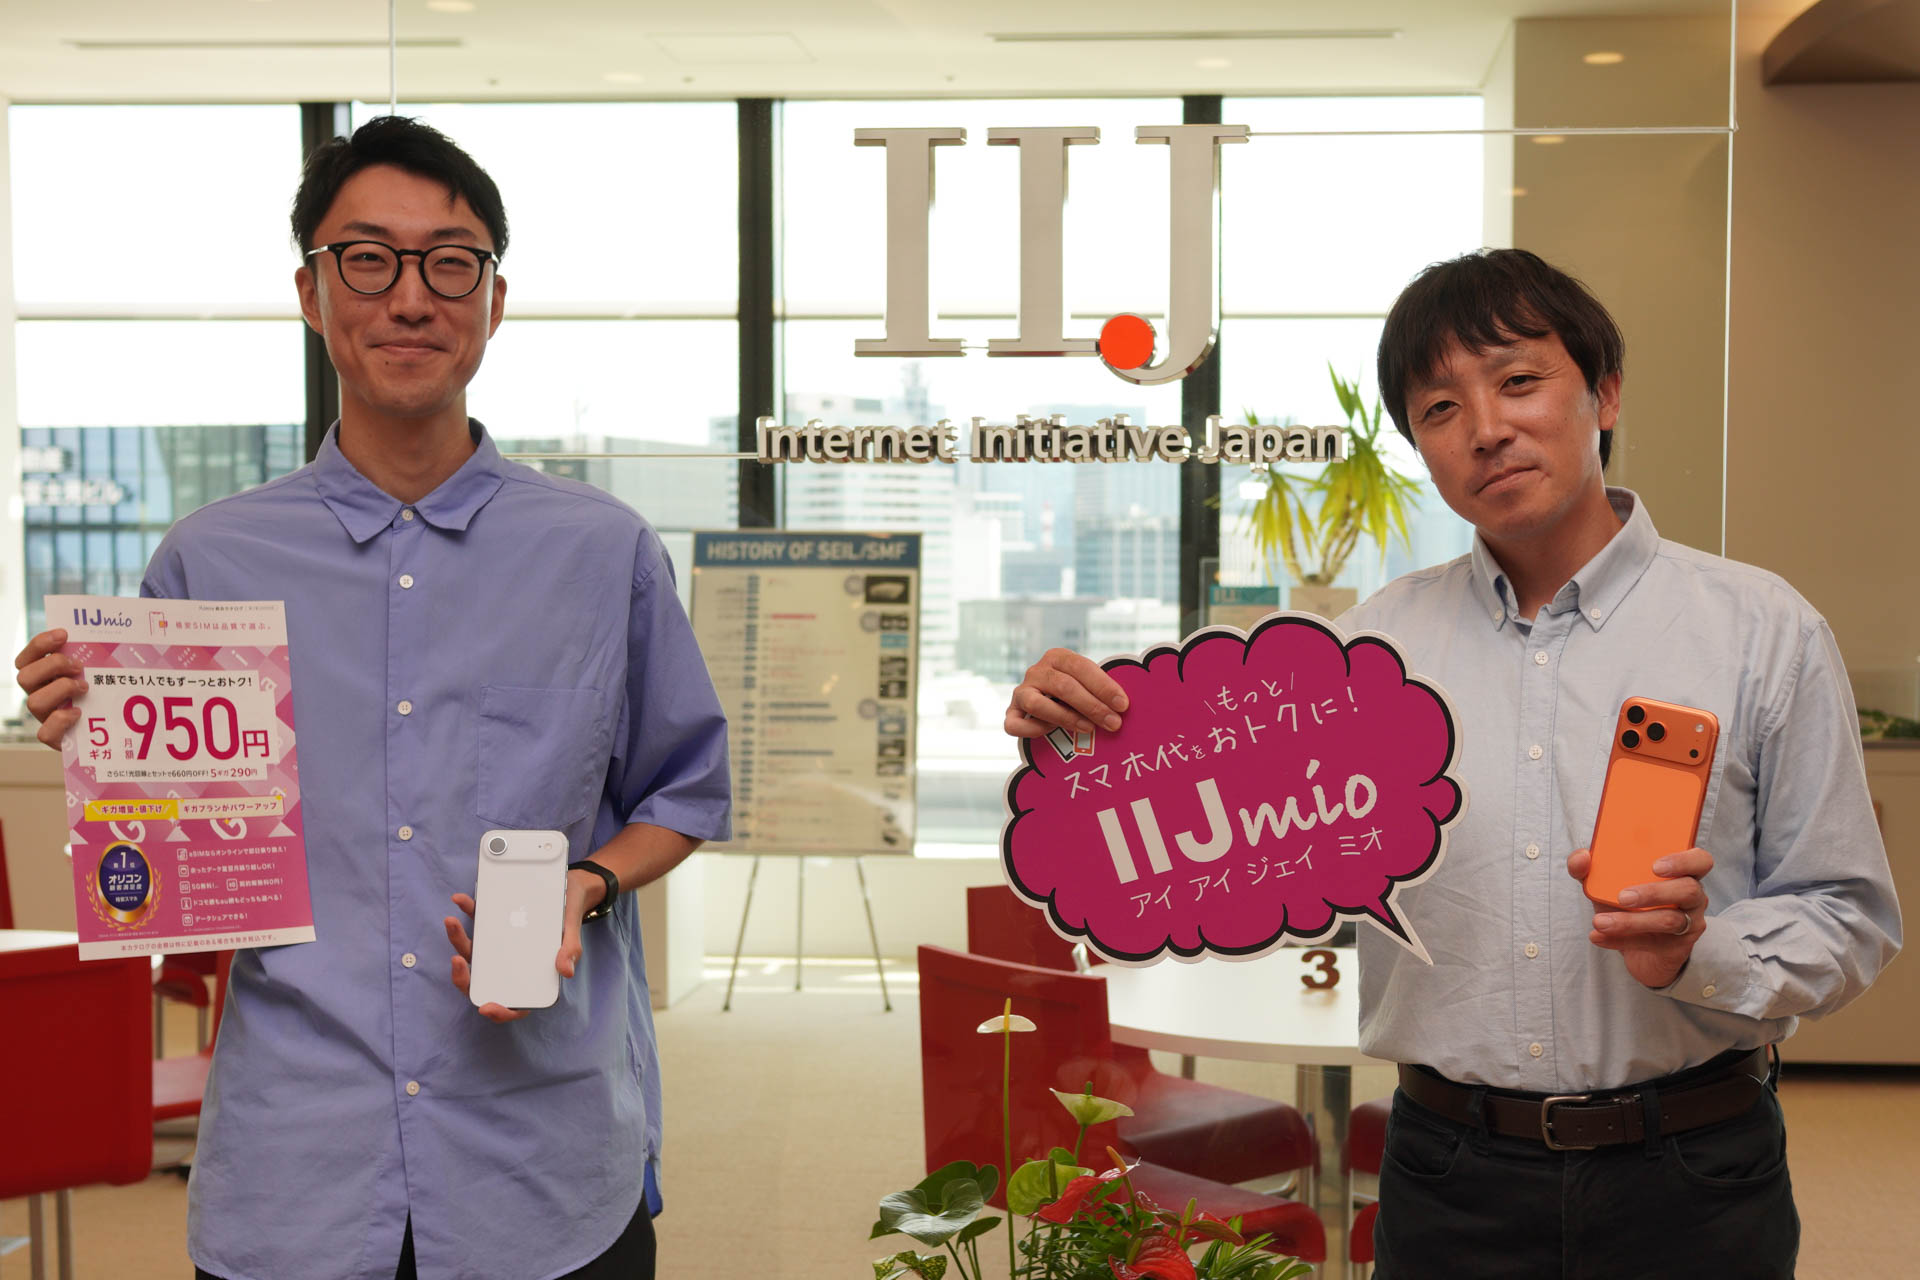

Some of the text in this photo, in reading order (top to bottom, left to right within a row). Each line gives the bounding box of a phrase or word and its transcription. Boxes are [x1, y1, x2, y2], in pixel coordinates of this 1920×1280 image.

[854, 124, 1250, 386] IIJ
[757, 413, 1351, 474] Internet Initiative Japan
[706, 540, 908, 561] HISTORY OF SEIL/SMF
[73, 608, 133, 628] IIJmio
[93, 674, 252, 688] 家族でも1人でもずーっとおトク！
[1217, 679, 1283, 712] もっと
[1097, 759, 1378, 884] IIJmio
[1246, 844, 1314, 885] ジェイ
[1337, 826, 1384, 856] ミオ
[108, 874, 142, 884] オリコン
[1300, 948, 1341, 990] 3
